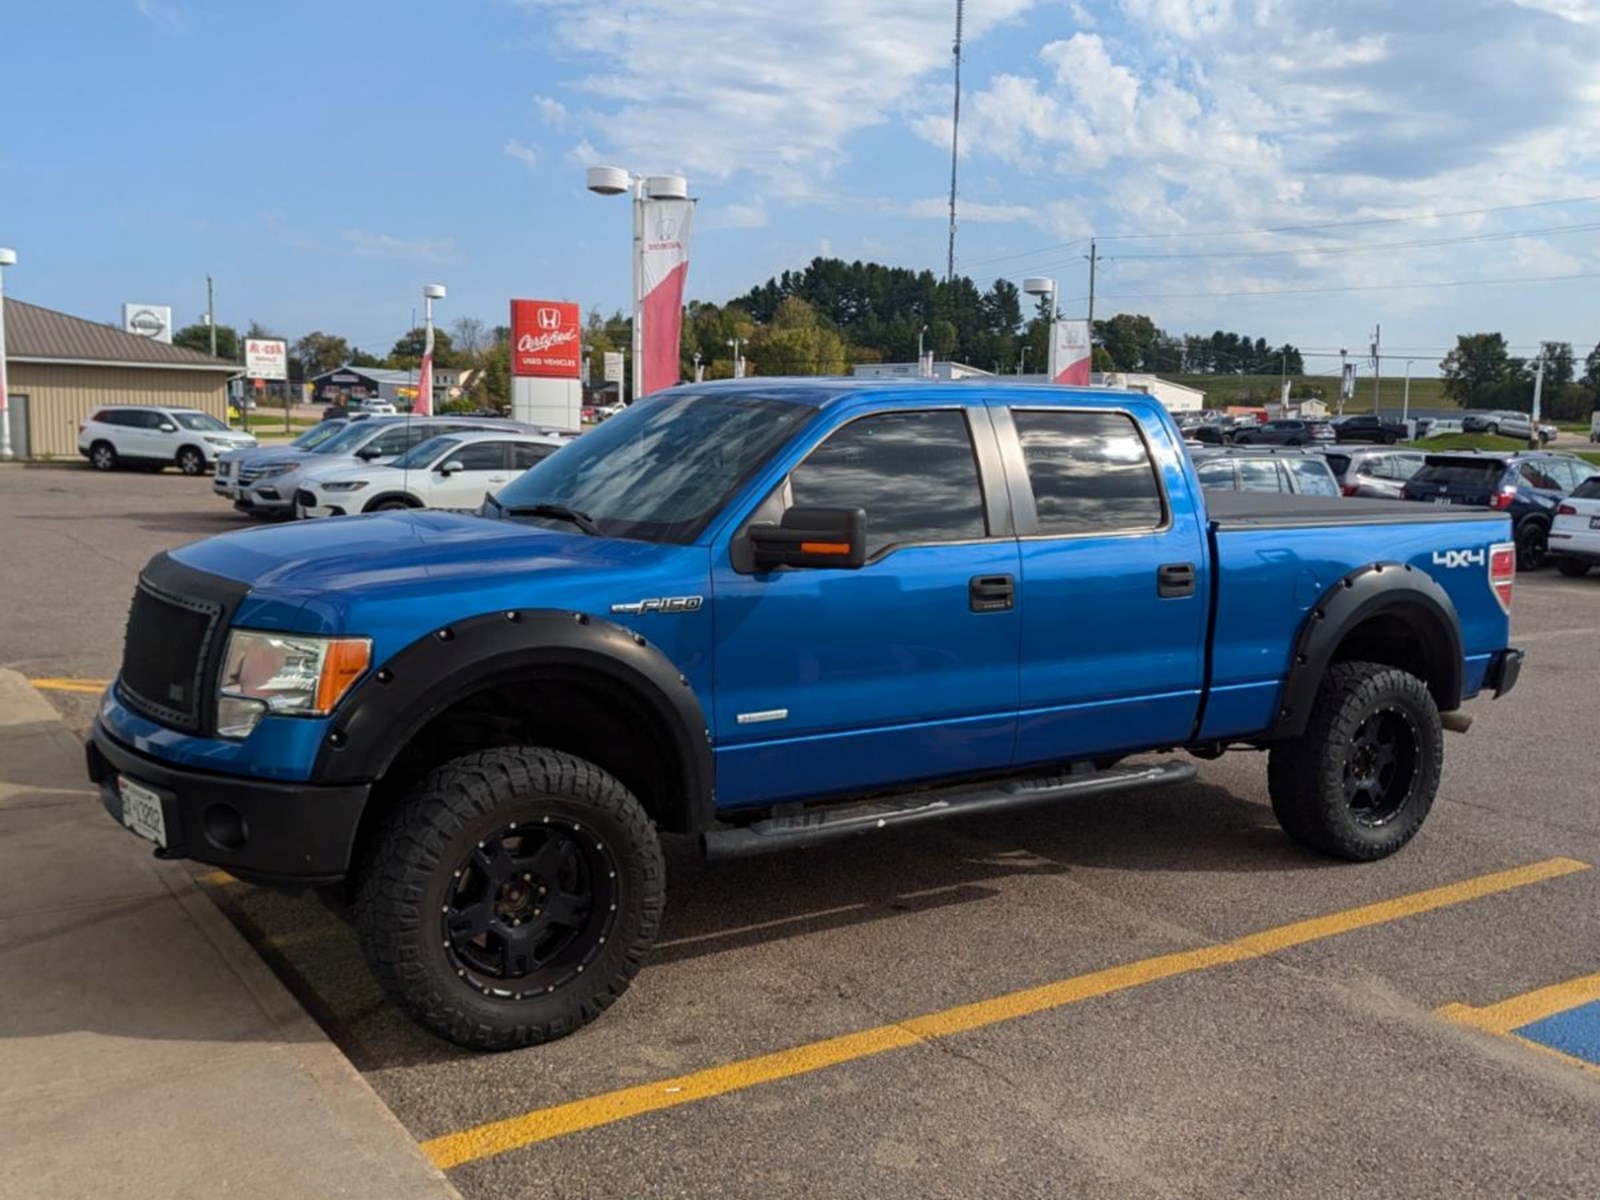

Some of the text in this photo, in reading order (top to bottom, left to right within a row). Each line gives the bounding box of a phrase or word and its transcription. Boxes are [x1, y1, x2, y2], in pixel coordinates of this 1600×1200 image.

[518, 328, 576, 352] Certified
[522, 358, 576, 367] USED VEHICLES
